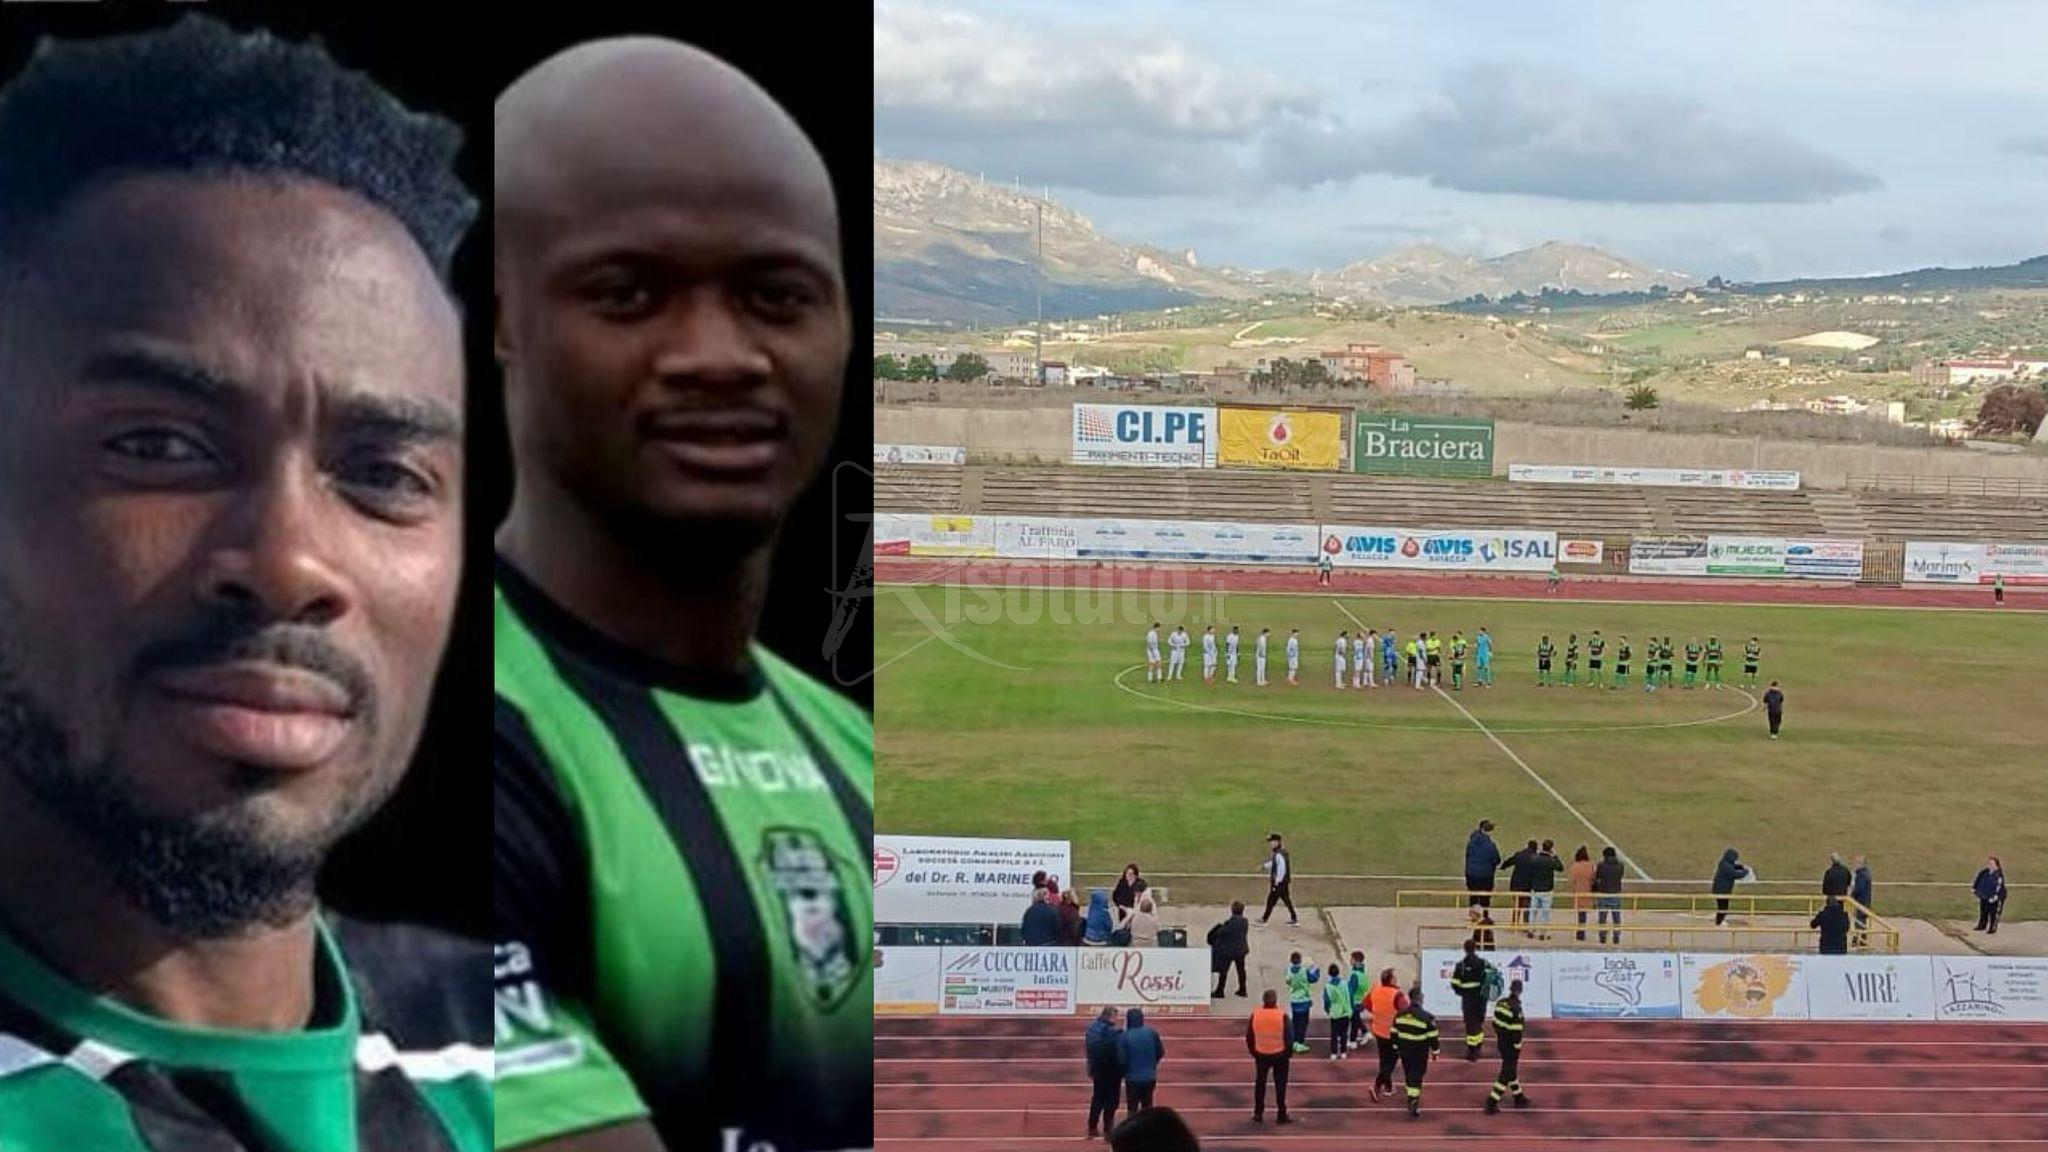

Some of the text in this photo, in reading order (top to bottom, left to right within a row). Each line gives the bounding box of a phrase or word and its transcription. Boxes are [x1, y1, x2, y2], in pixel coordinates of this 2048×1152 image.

[1391, 418, 1409, 432] La
[1364, 431, 1485, 460] Braciera
[1346, 536, 1397, 553] AVIS
[1423, 537, 1474, 555] AVIS
[1503, 540, 1555, 558] ISAL
[905, 871, 926, 884] del
[931, 871, 949, 884] Dr.
[955, 872, 969, 884] R.
[984, 951, 1069, 972] CUCCHIARA
[1603, 956, 1637, 970] Isola
[1112, 950, 1184, 1002] Rossi
